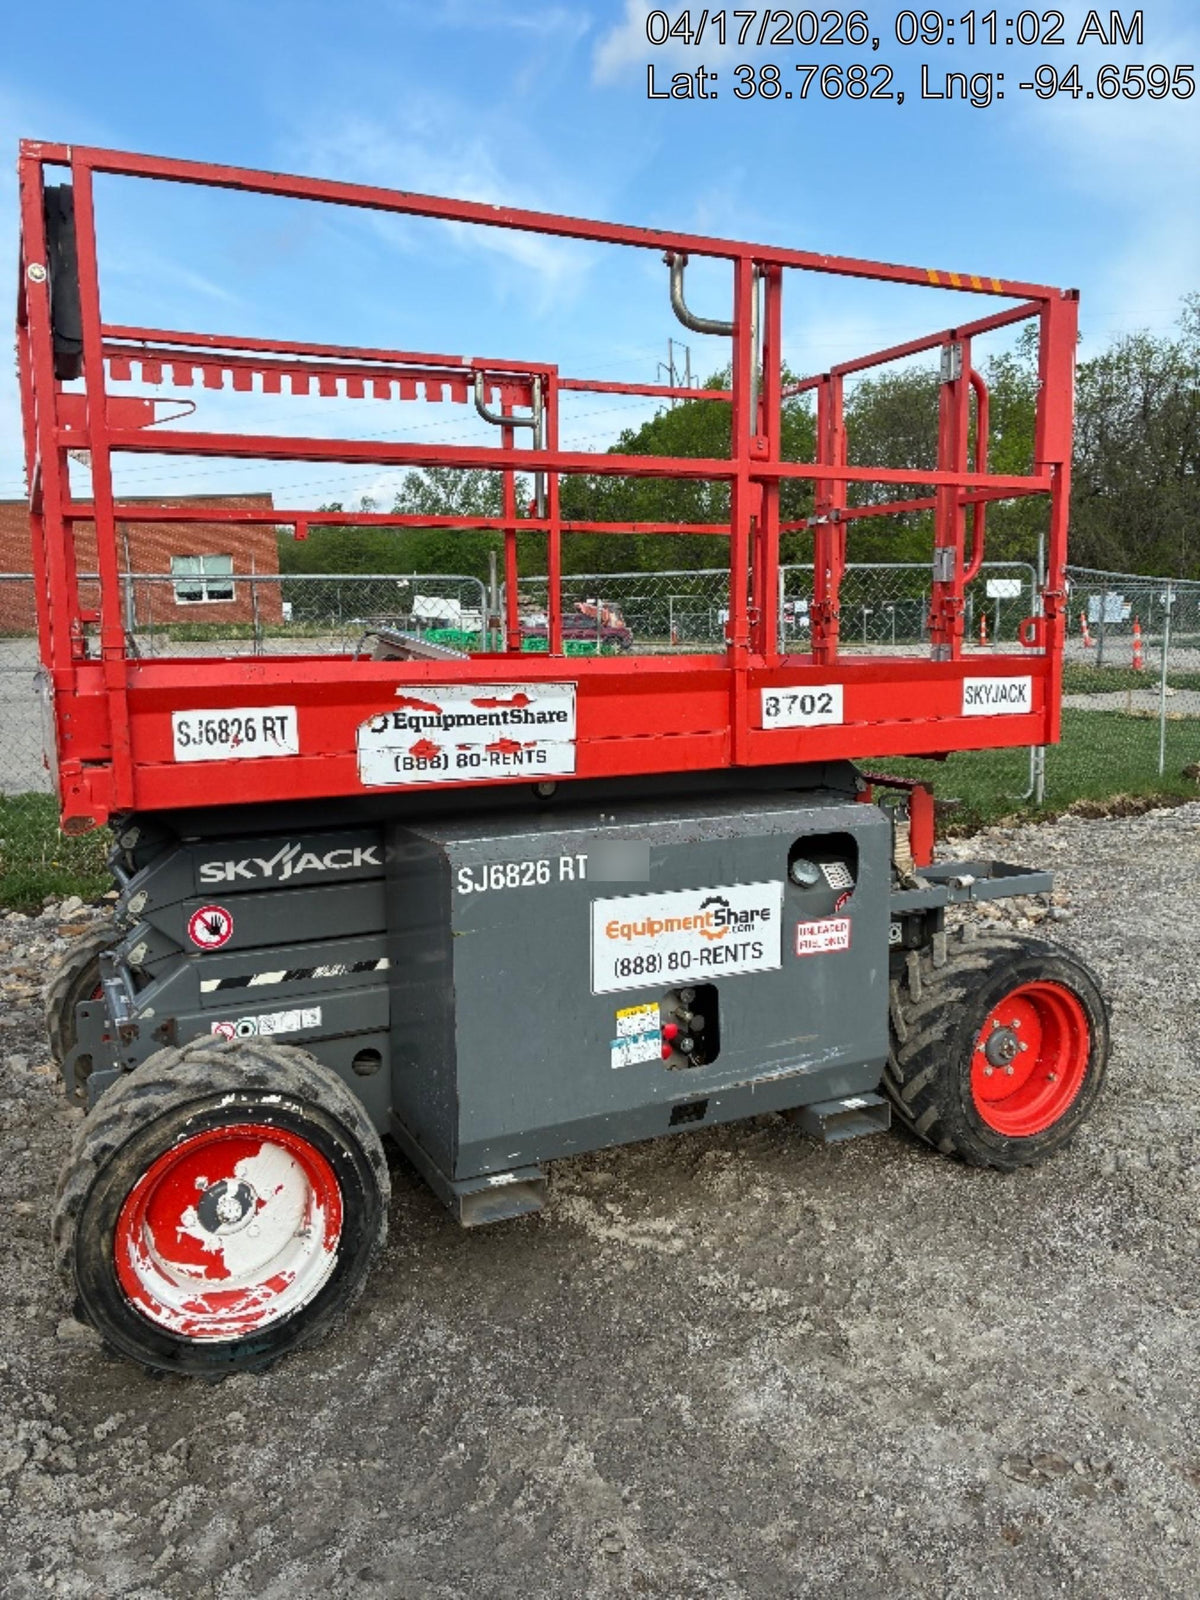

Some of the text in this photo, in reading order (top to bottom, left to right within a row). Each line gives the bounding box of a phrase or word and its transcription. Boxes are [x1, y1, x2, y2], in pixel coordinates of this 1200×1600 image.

[765, 692, 833, 718] 8702
[964, 683, 1028, 706] SKYJACK
[177, 715, 289, 748] SJ6826 RT
[392, 708, 568, 733] EquipmentShare
[394, 749, 547, 772] (888) 80-RENTS
[199, 842, 383, 883] SKYJACK
[457, 854, 588, 895] SJ6826 RT
[605, 907, 771, 941] EquipmentShare
[799, 921, 848, 937] UNLEADED
[799, 934, 848, 950] FUEL ONLY
[614, 941, 764, 979] (888) 80-RENTS
